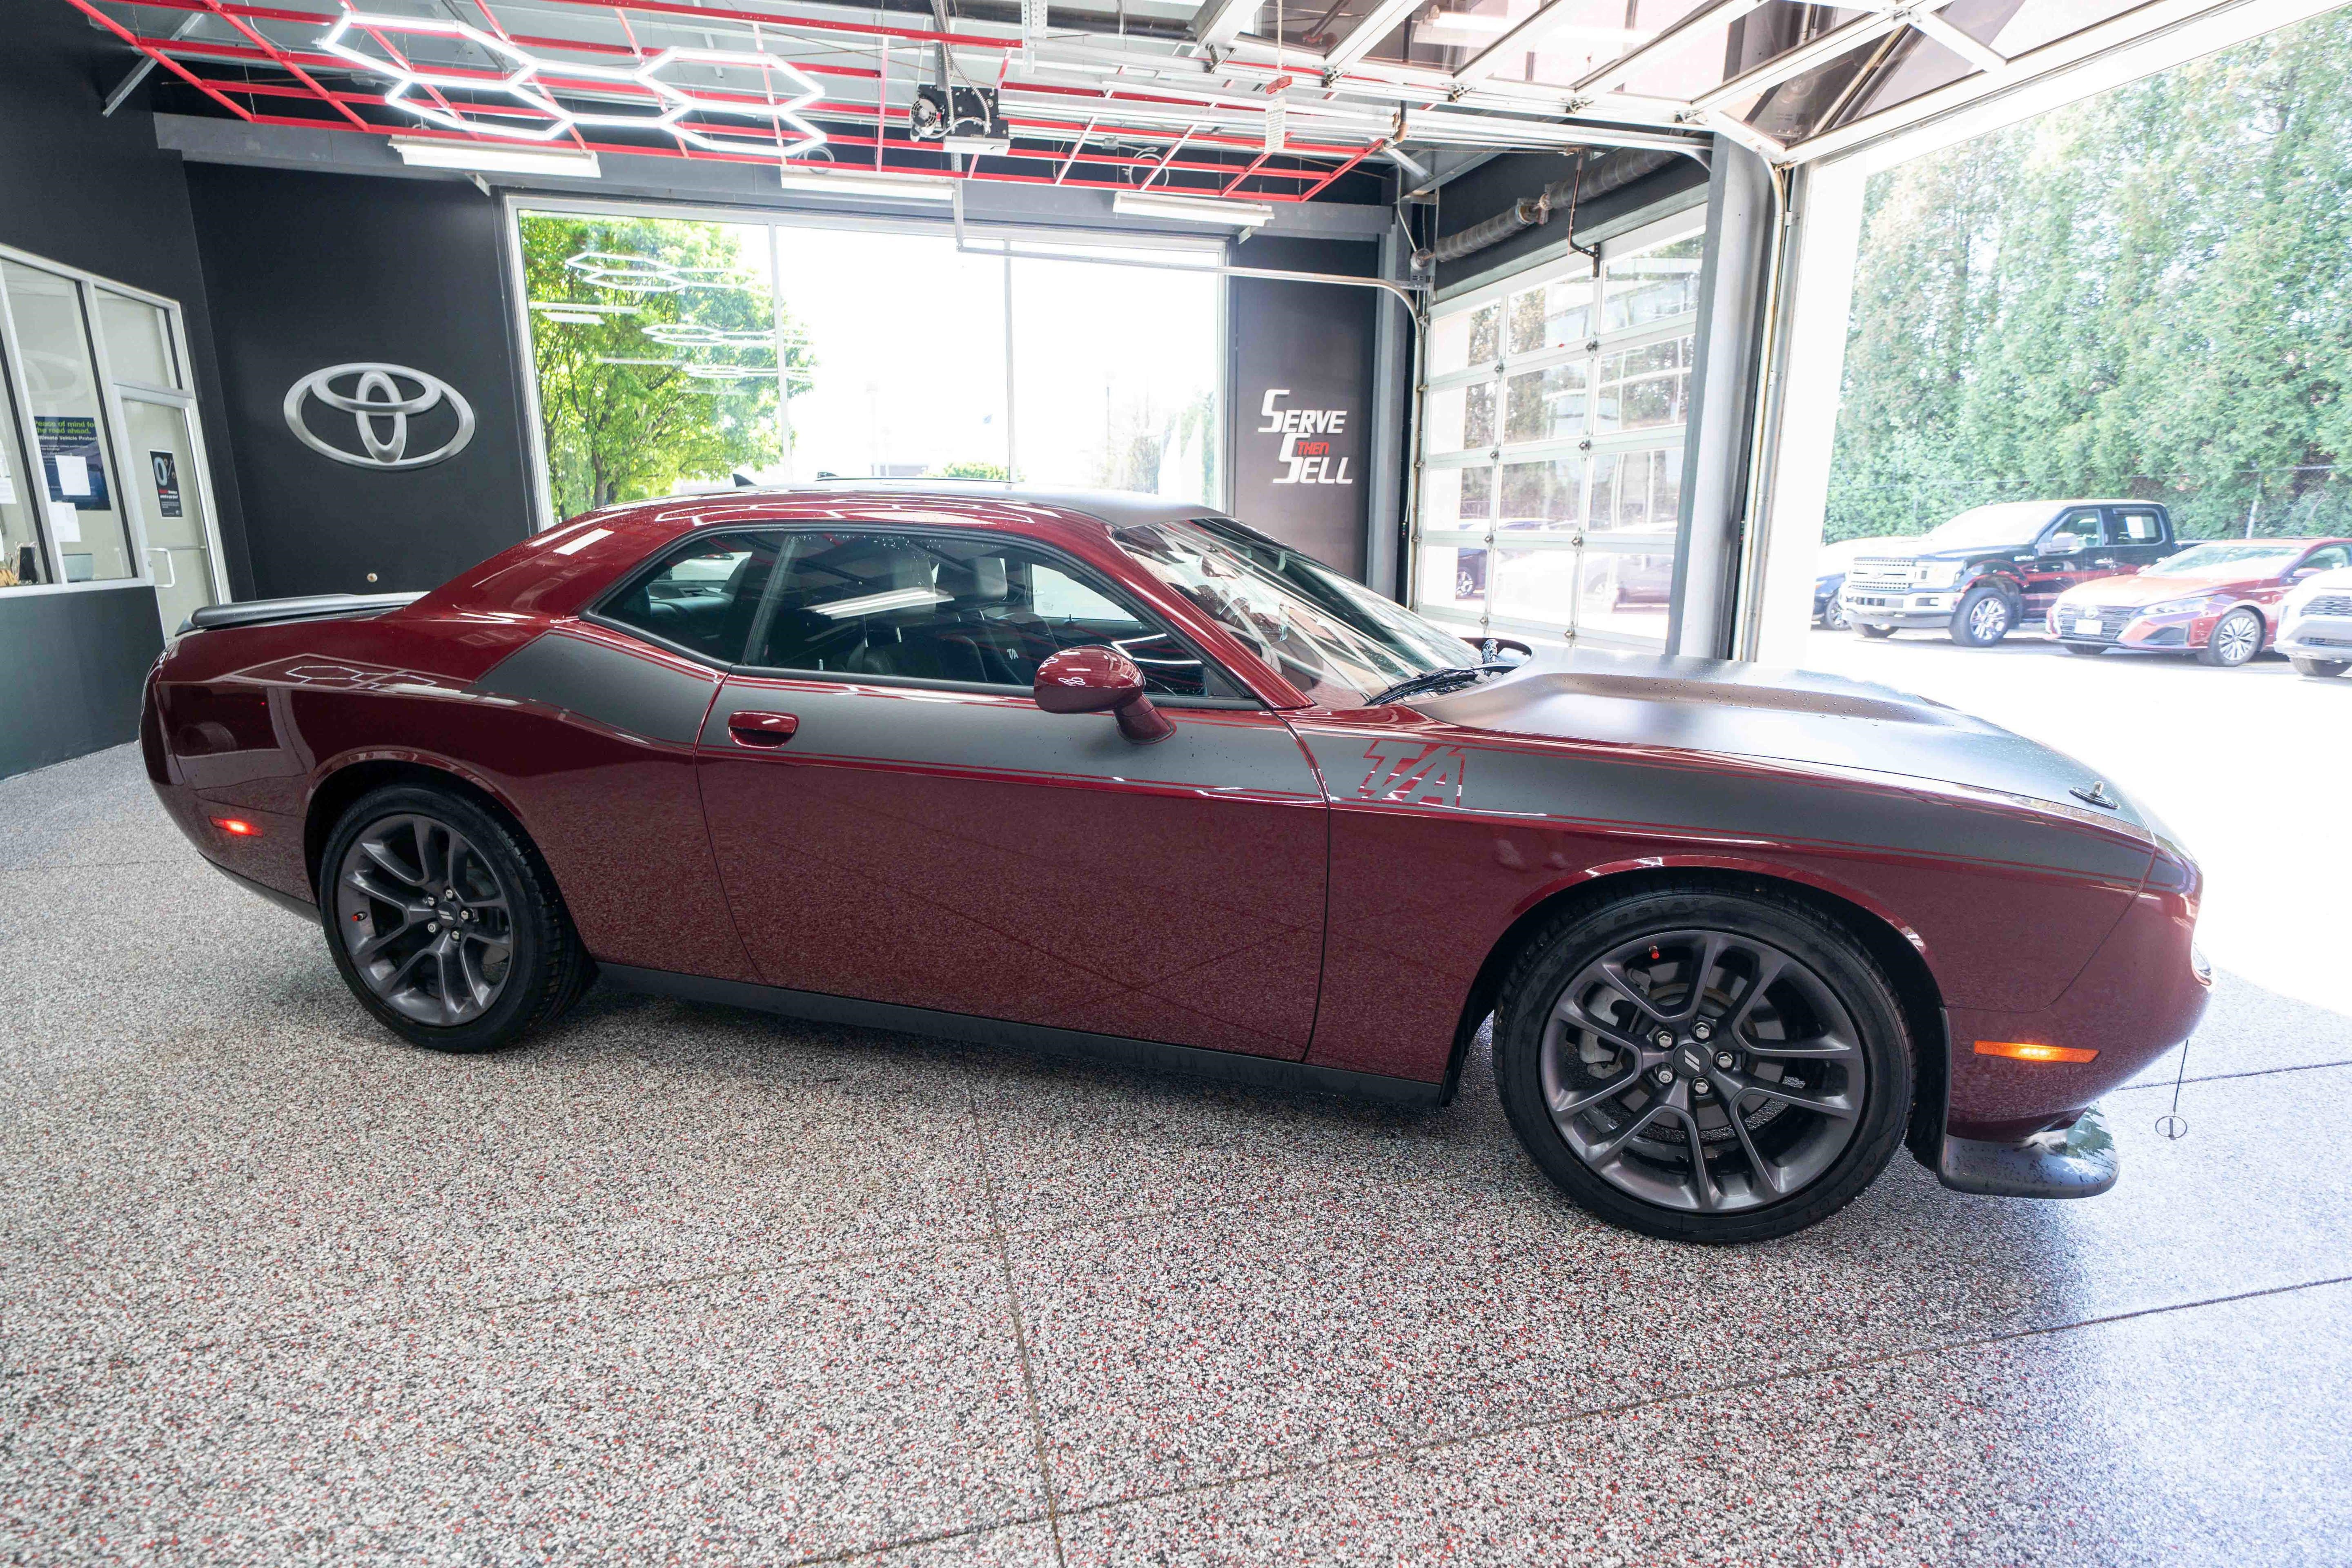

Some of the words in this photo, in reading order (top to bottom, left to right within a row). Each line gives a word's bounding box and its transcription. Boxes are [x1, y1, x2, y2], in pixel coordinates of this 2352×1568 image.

[1258, 389, 1347, 433] SERVE
[1272, 432, 1353, 484] SELL
[1297, 441, 1330, 455] THEN
